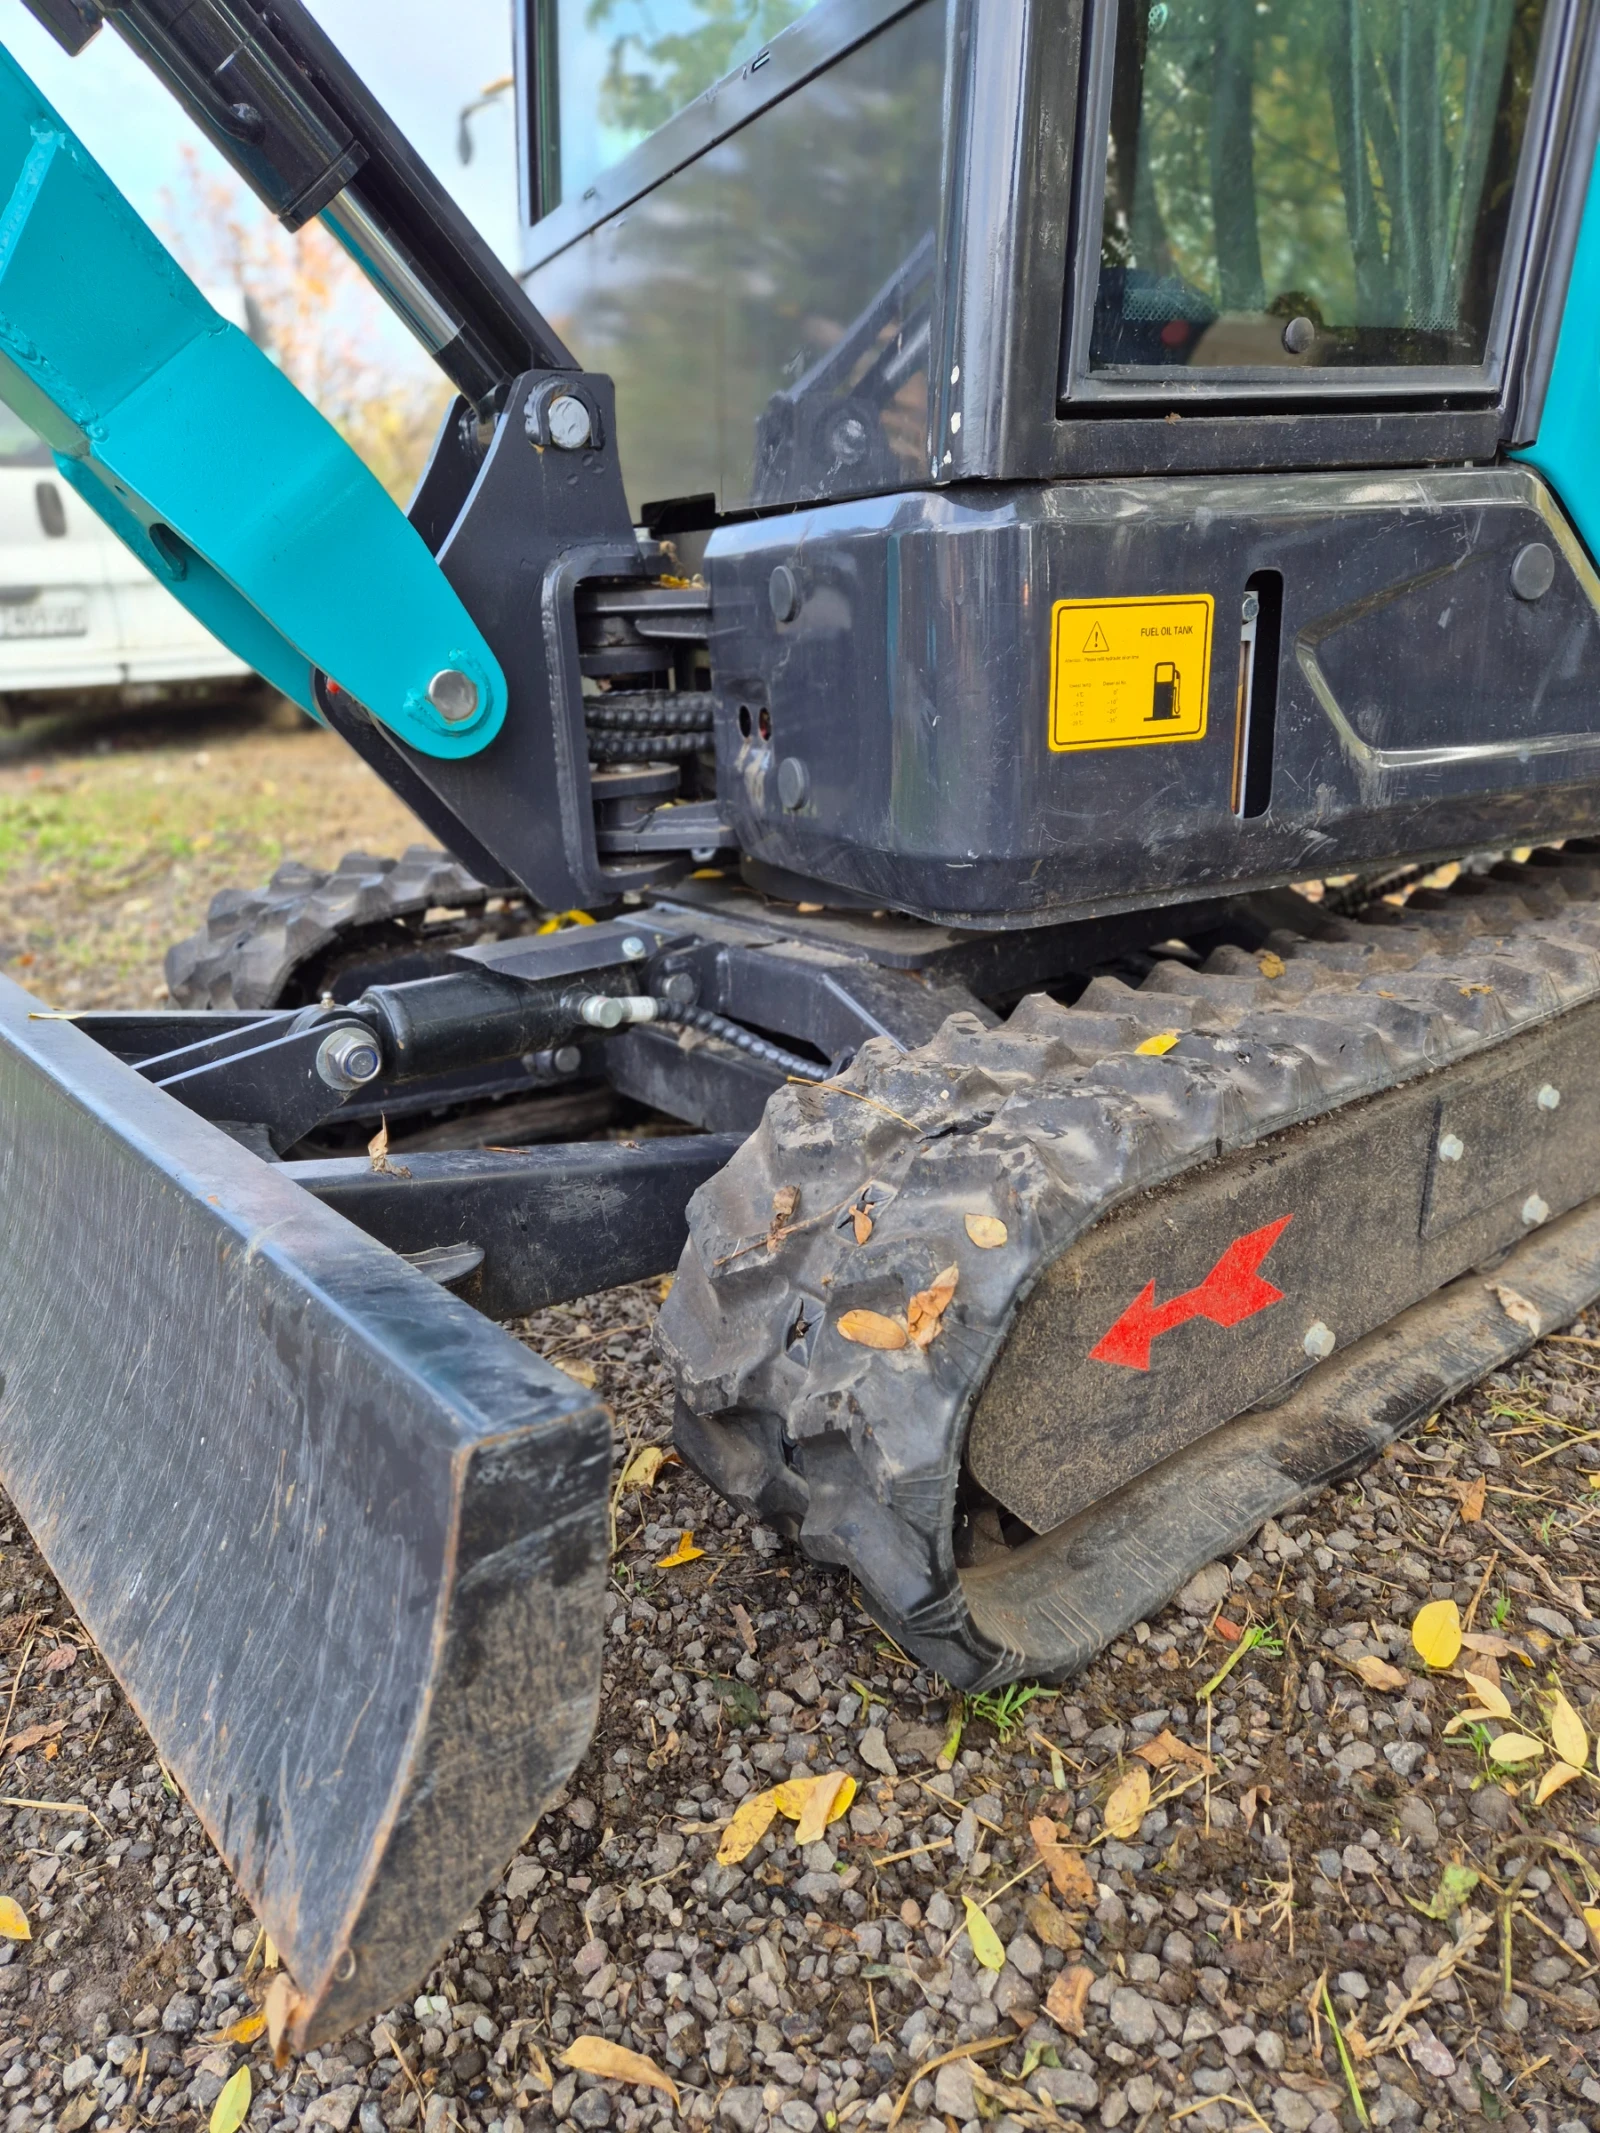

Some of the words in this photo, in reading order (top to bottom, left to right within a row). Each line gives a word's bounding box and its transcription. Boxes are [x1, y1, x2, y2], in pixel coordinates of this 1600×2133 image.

[1140, 627, 1159, 638] FUEL
[1160, 626, 1172, 637] OIL
[1173, 625, 1193, 636] TANK
